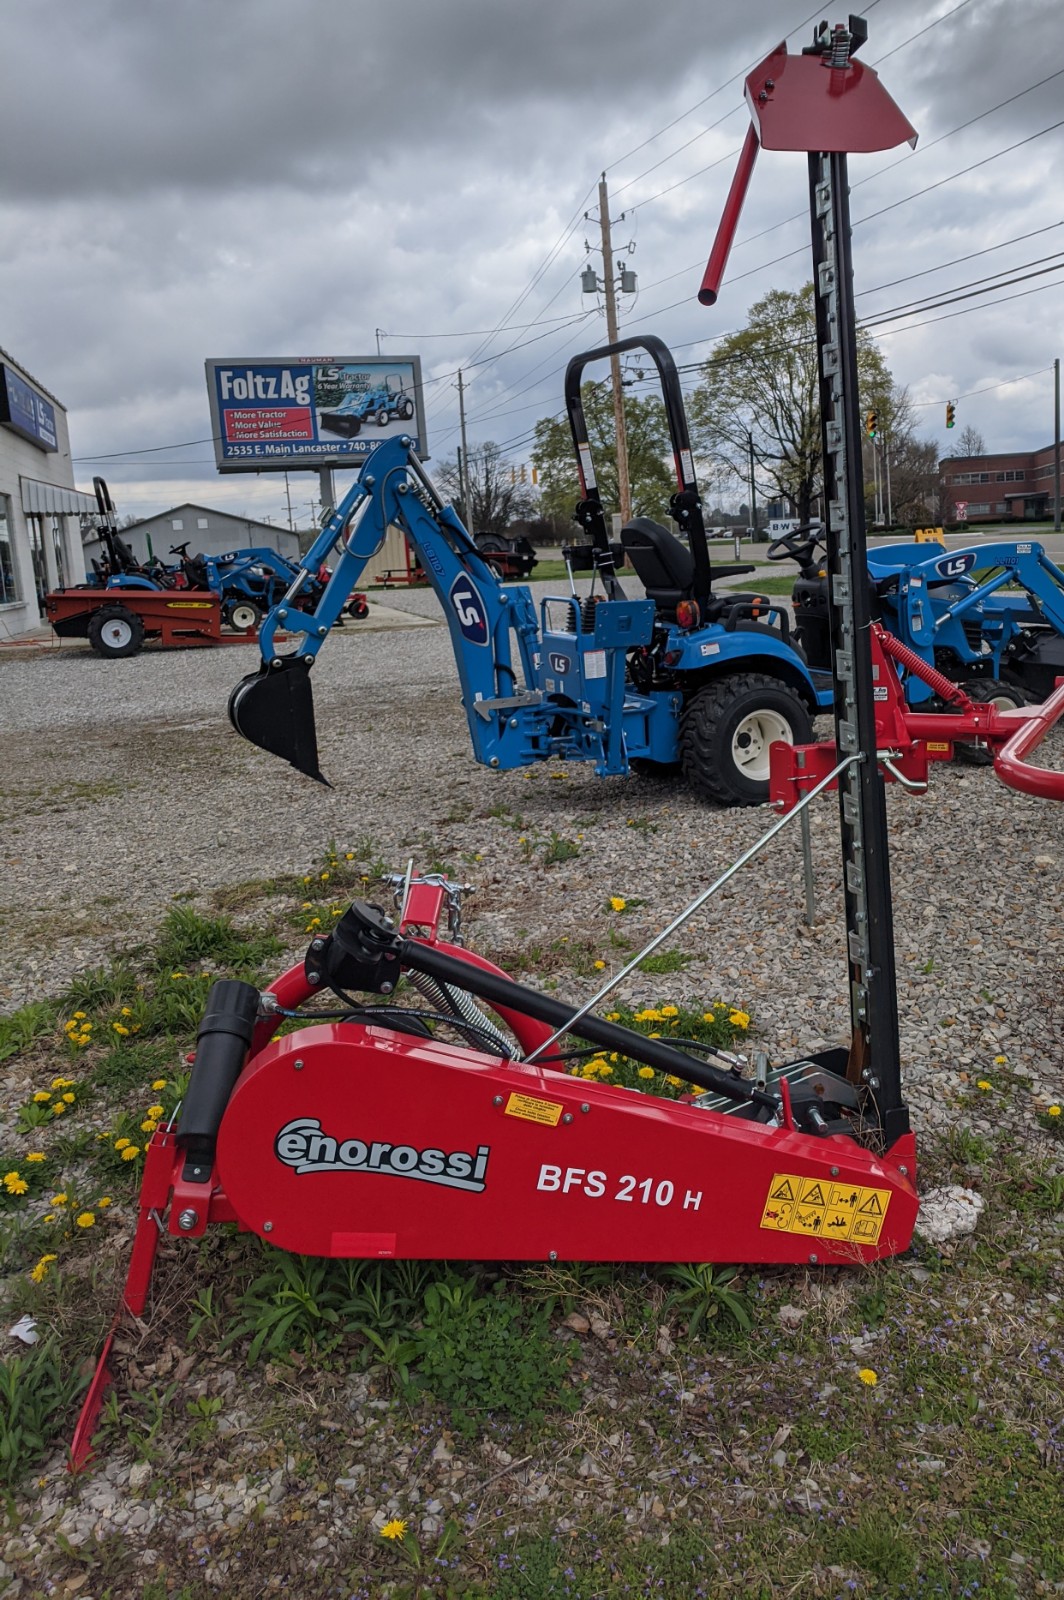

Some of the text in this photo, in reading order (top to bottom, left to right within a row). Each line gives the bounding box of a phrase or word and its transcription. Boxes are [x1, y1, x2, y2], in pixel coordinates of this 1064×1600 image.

[318, 368, 339, 381] LS
[339, 382, 370, 390] Warranty
[260, 430, 308, 438] Satisfaction
[227, 446, 252, 456] 2535
[255, 445, 264, 454] E.
[266, 444, 291, 454] Main
[292, 442, 340, 454] Lancaster
[947, 558, 966, 575] LS
[454, 592, 480, 626] LS
[554, 658, 566, 672] LS
[276, 1129, 489, 1180] enorossi
[536, 1164, 704, 1211] BFS 210 H
